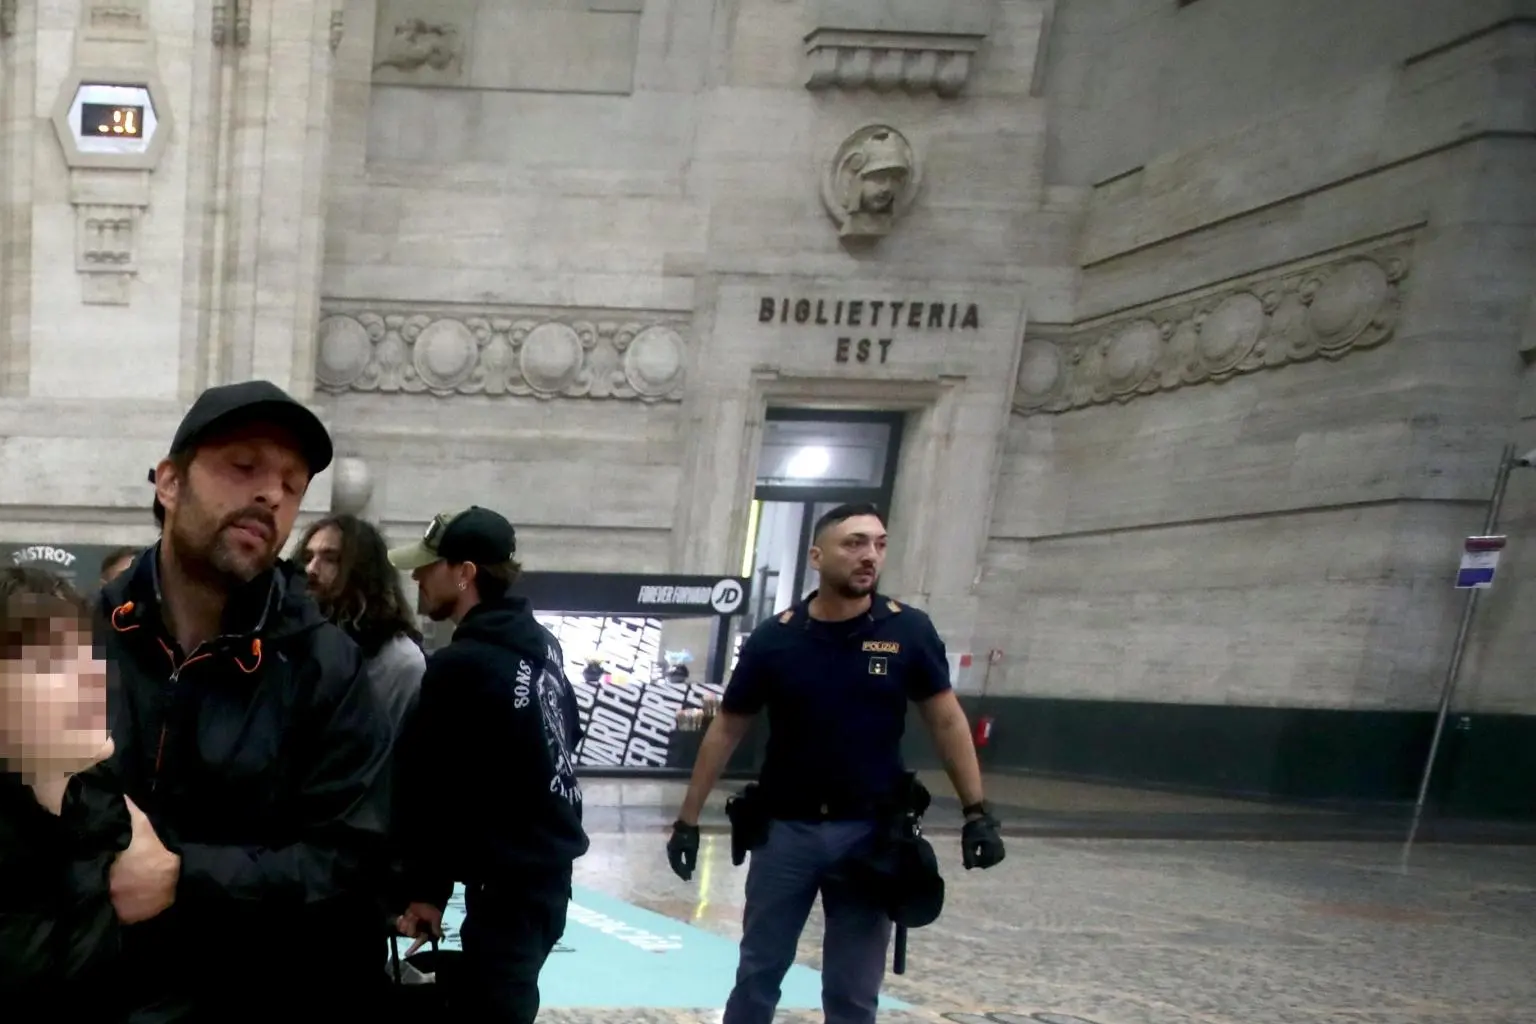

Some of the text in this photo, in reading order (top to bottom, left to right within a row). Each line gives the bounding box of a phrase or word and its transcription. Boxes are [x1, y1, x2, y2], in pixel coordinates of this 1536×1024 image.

[758, 297, 979, 329] BIGLIETTERIA
[834, 336, 893, 364] EST
[514, 660, 533, 708] SONS
